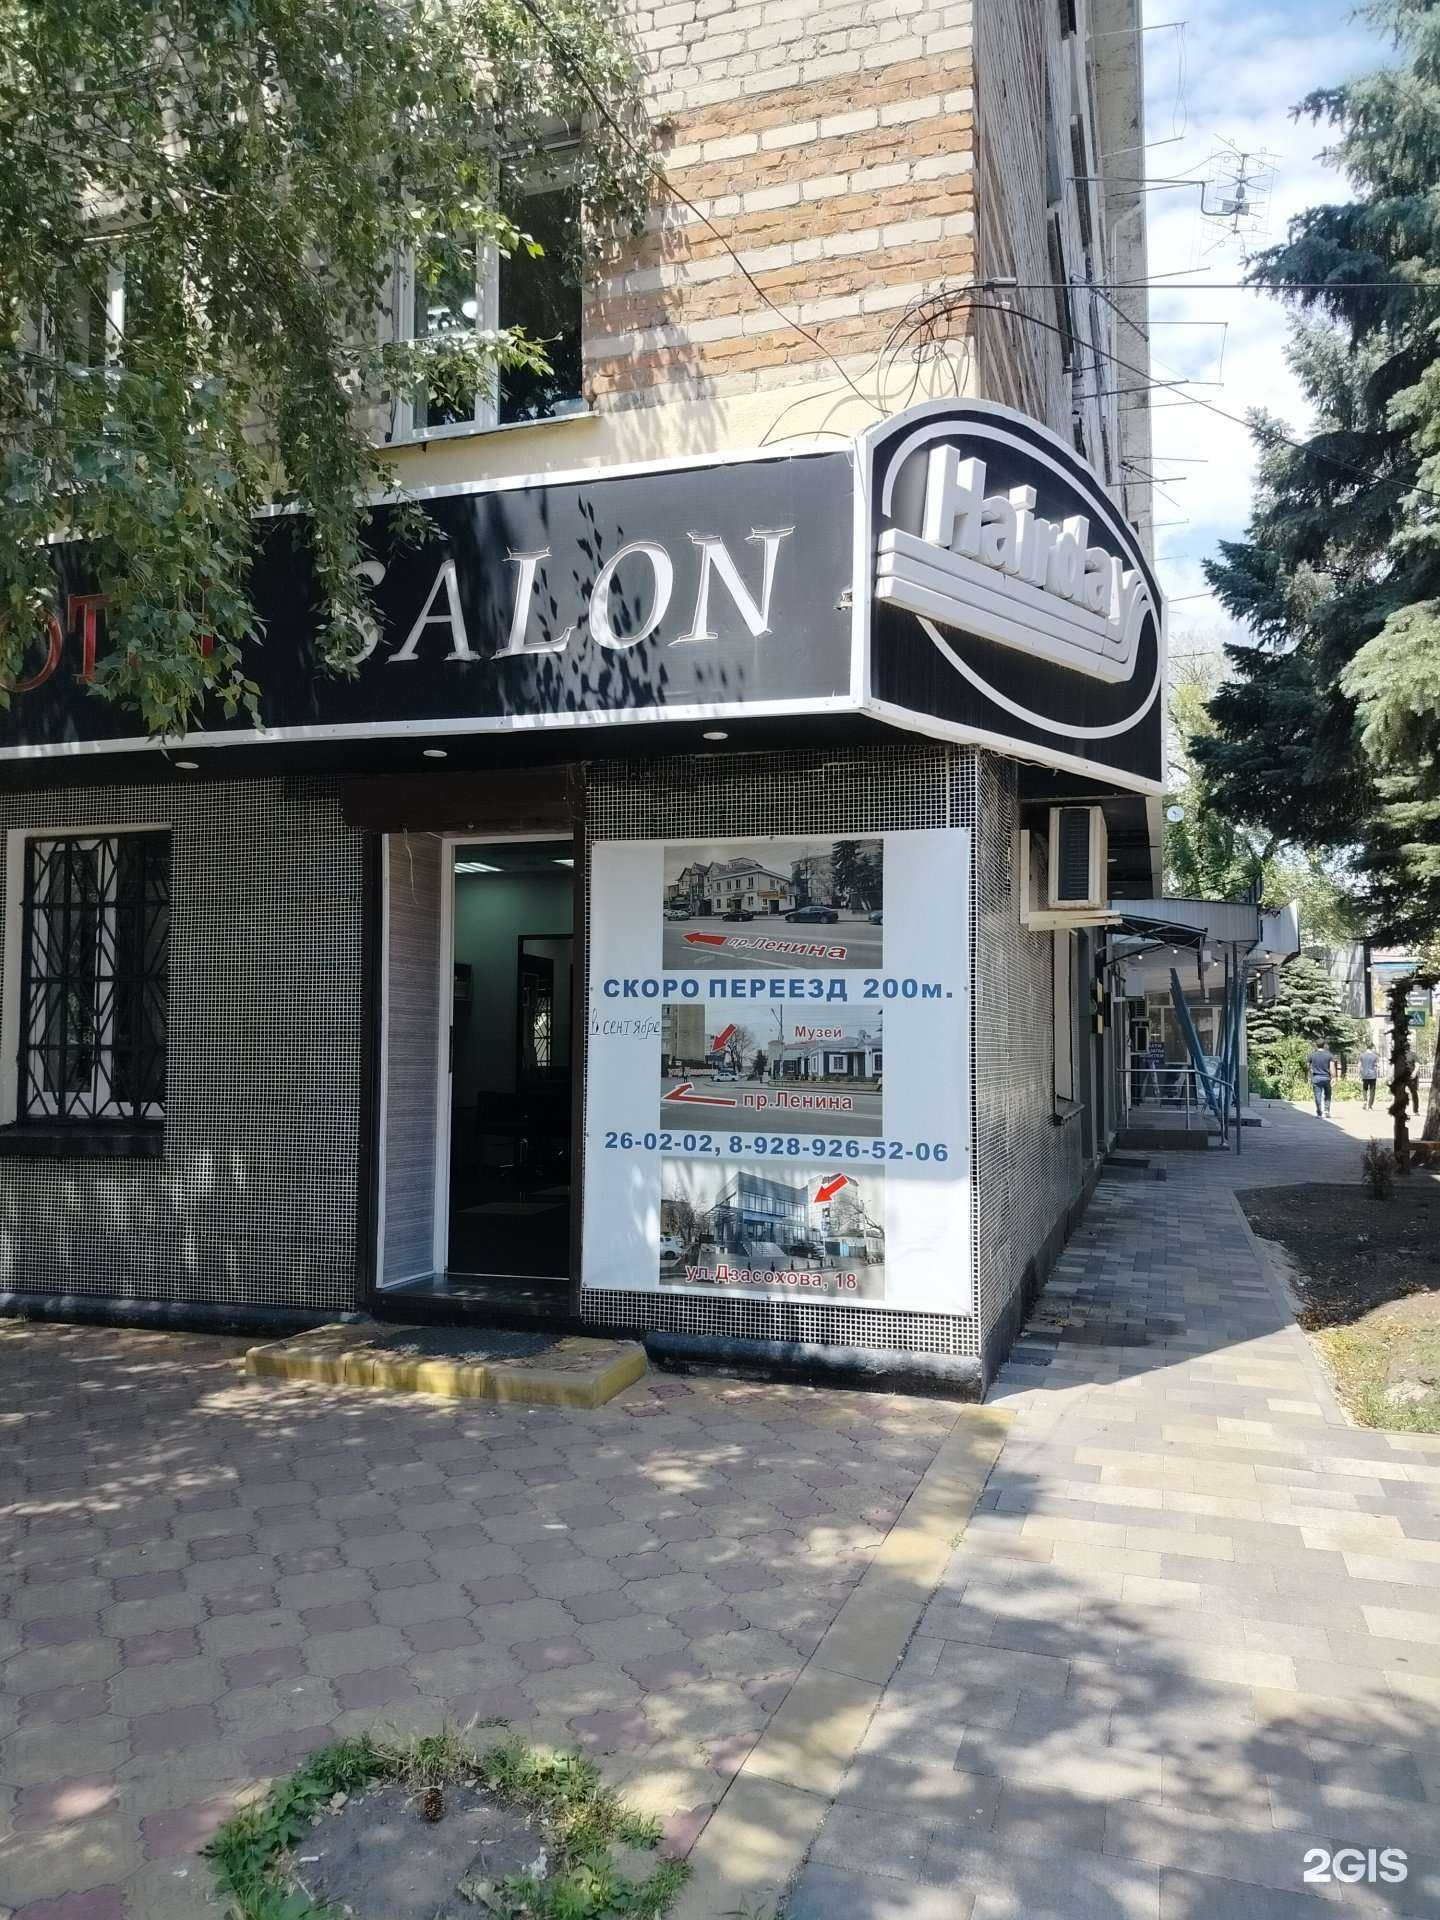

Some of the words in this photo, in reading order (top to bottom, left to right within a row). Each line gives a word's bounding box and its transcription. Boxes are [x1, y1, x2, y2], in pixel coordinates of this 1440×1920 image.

[922, 444, 1146, 630] Hairday
[325, 525, 797, 672] SALON
[728, 937, 847, 961] пр.Ленина
[603, 978, 700, 999] СКОРО
[709, 978, 848, 1003] ПЕРЕЕЗД
[863, 978, 953, 999] 200м.
[742, 1091, 853, 1111] пр.Ленина
[604, 1131, 721, 1157] 26-02-02,
[729, 1135, 948, 1162] 8-928-926-52-06
[835, 1273, 857, 1289] 18
